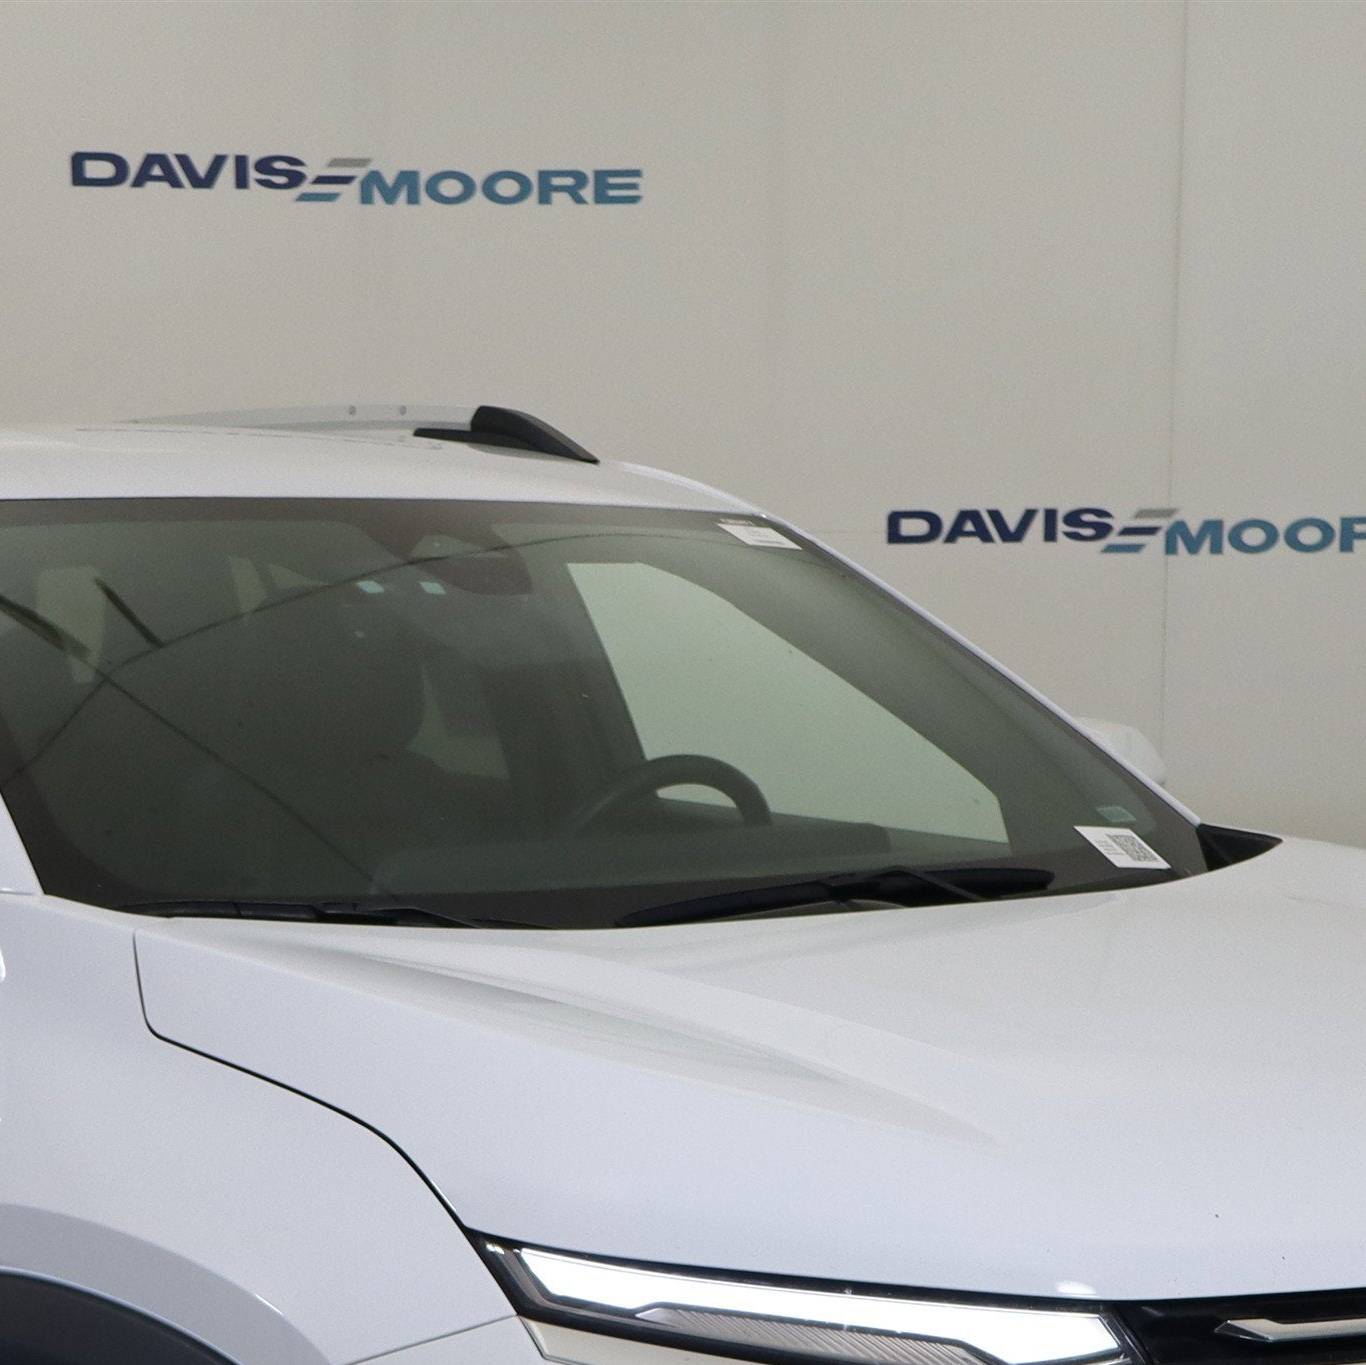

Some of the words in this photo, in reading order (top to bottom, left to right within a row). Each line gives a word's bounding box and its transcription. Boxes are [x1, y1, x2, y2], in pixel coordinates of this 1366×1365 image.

[70, 151, 309, 189] DAVIS
[359, 168, 644, 206] MOORE
[886, 507, 1114, 544] DAVIS
